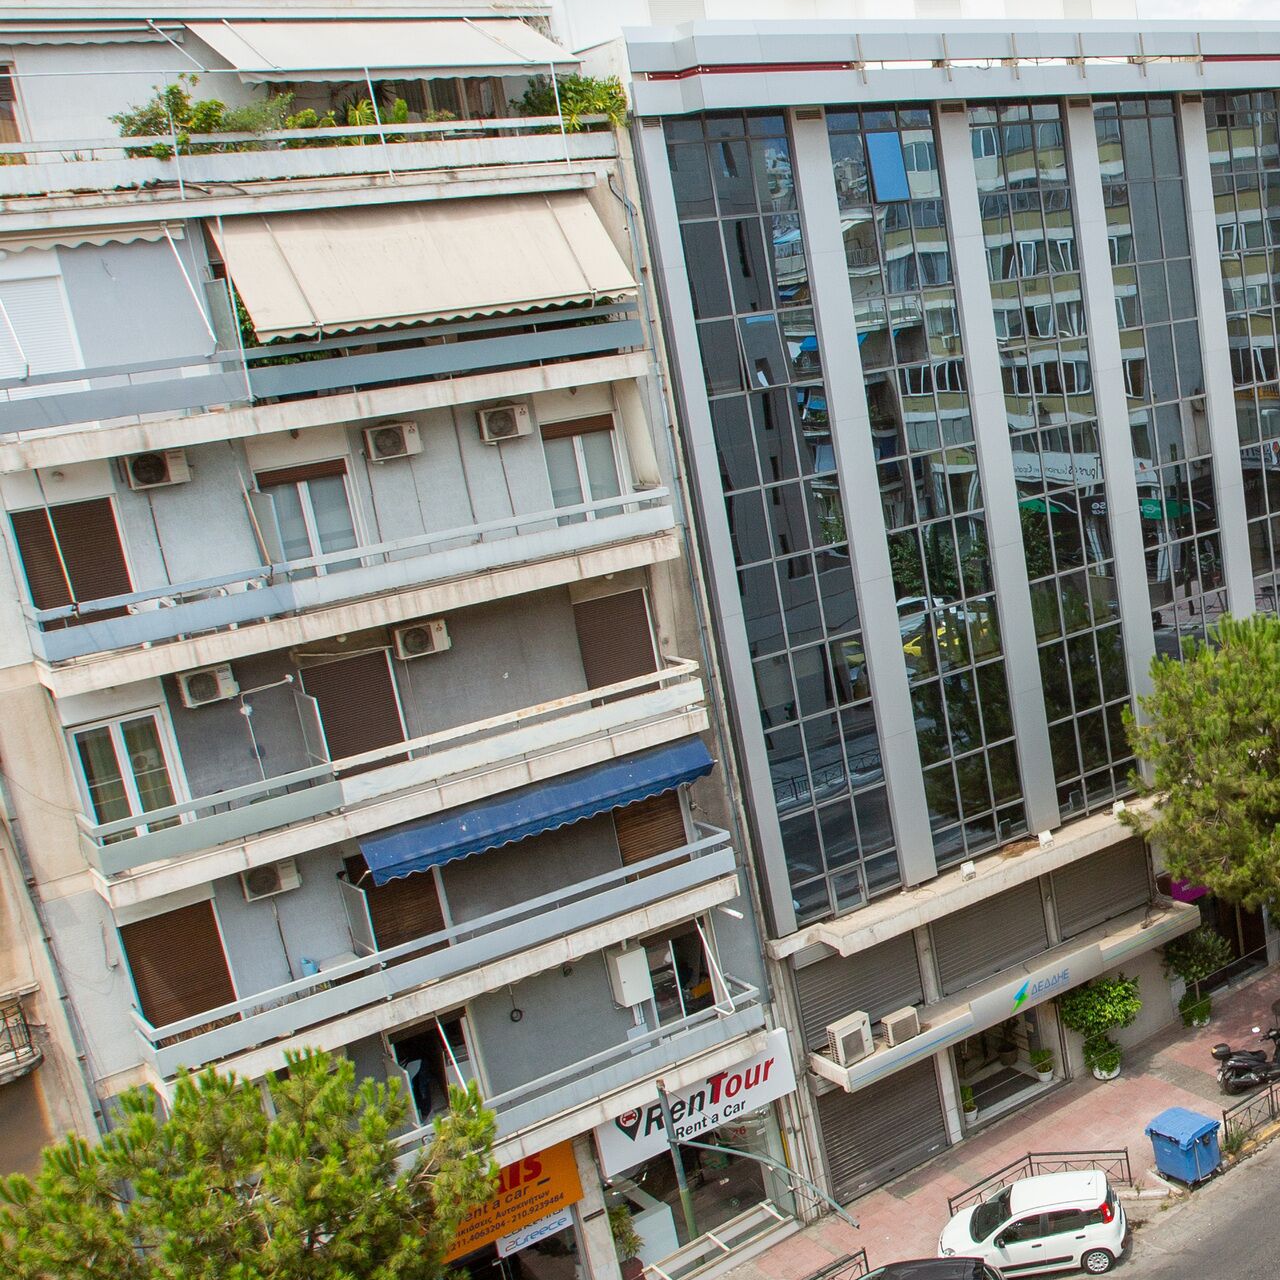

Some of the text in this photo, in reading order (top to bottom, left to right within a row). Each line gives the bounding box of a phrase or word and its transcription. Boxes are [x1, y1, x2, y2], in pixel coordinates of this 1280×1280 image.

[1031, 967, 1070, 995] ΔΕΔΔΗΕ
[676, 1099, 746, 1139] Rent a Car
[492, 1200, 501, 1210] a
[505, 1185, 530, 1203] car
[504, 1216, 568, 1252] 2Greece
